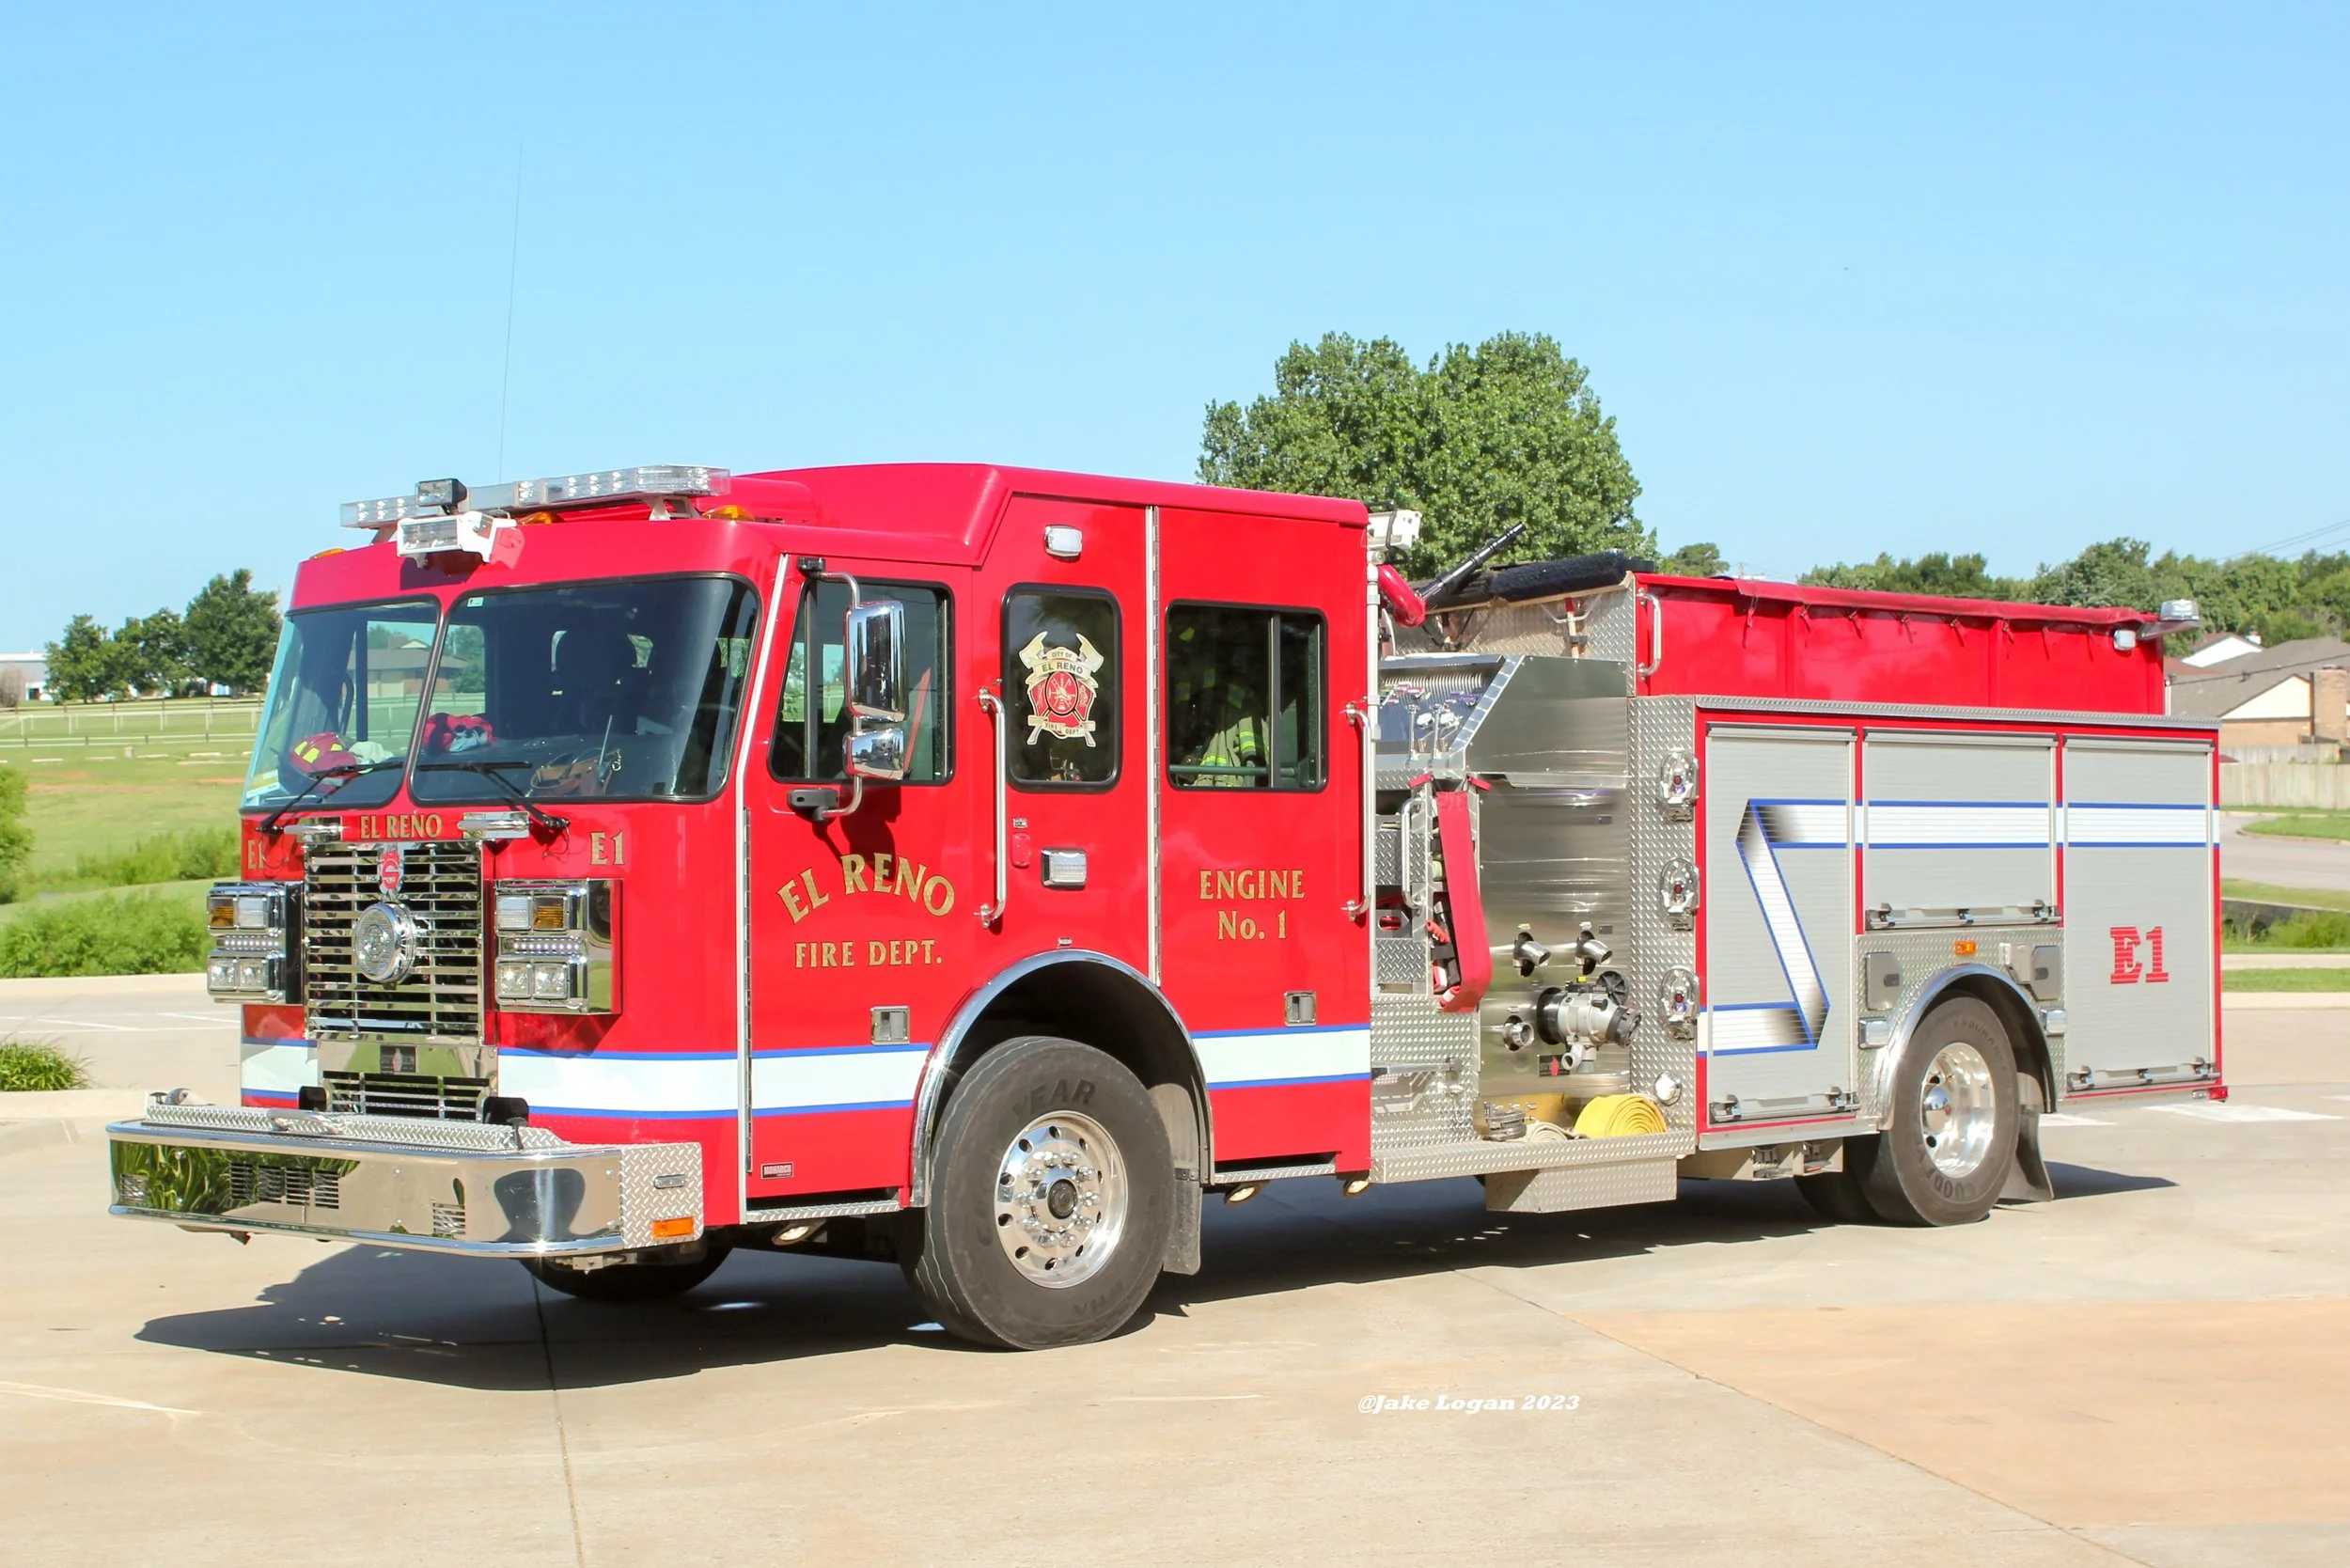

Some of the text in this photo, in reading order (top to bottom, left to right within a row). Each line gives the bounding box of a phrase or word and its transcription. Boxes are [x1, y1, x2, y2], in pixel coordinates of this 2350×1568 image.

[1042, 662, 1084, 674] EL RENO
[359, 813, 444, 839] EL RENO
[589, 830, 625, 866] E1
[776, 852, 956, 925] EL RENO
[1198, 869, 1306, 901] ENGINE
[1217, 909, 1288, 941] No. 1
[794, 939, 943, 968] FIRE DEPT.
[2109, 926, 2170, 984] E1
